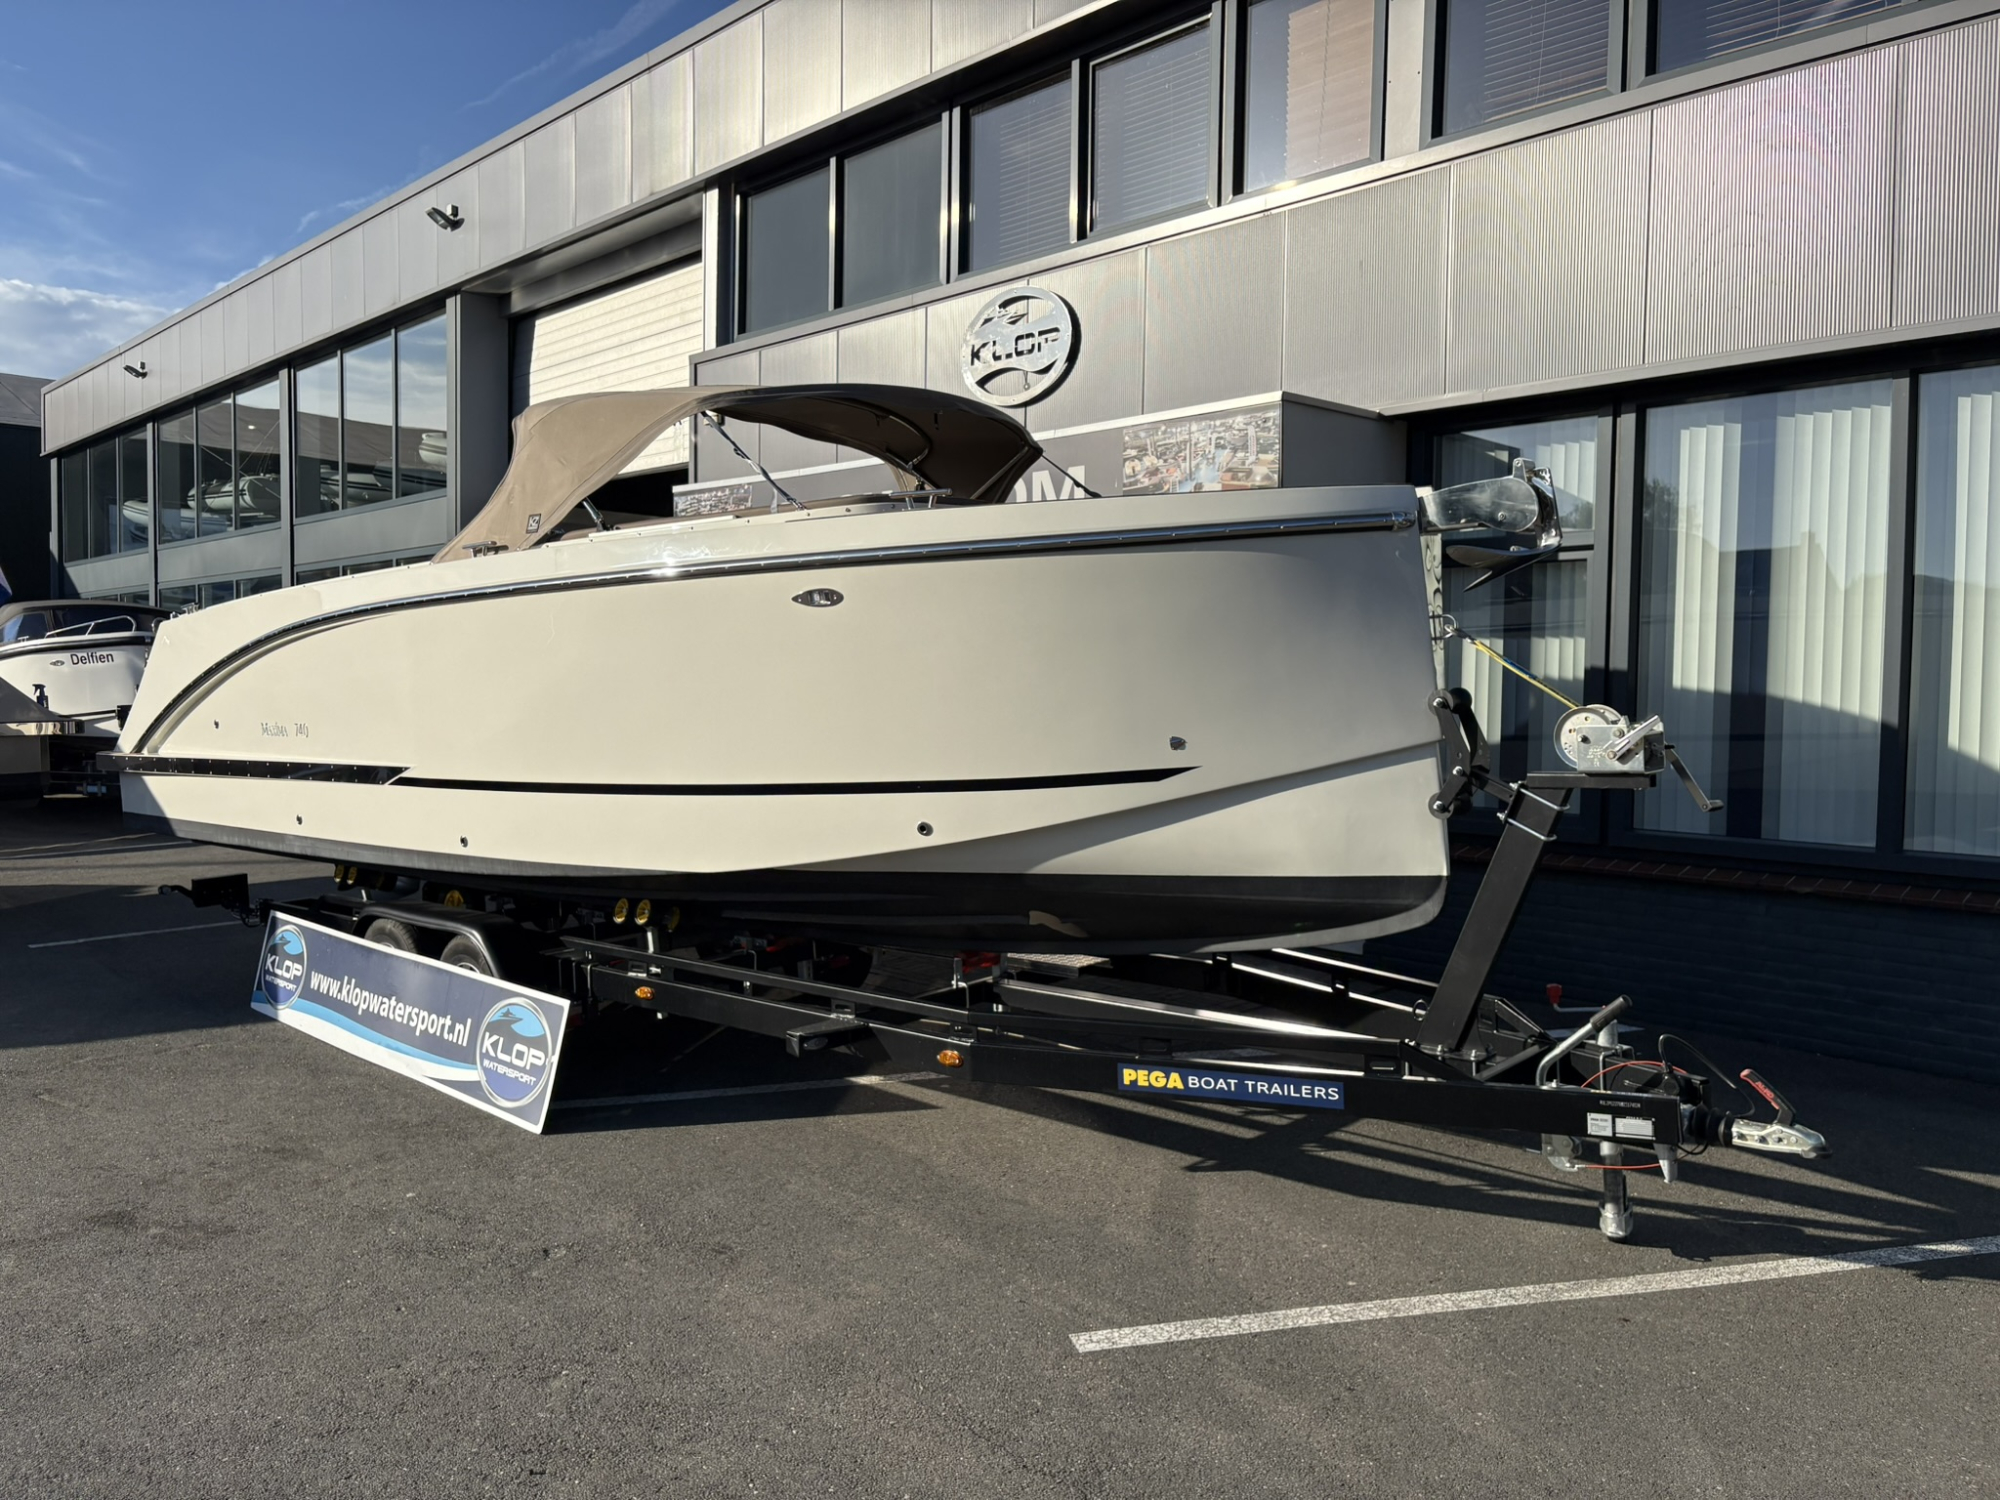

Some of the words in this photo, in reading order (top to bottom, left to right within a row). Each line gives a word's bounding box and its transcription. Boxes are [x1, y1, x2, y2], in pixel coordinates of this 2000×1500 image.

[970, 326, 1061, 366] KLOP
[70, 652, 115, 666] Delfien
[265, 953, 303, 981] KLOP
[265, 974, 298, 992] WATERSPORT
[310, 970, 472, 1047] www.klopwatersport.nl
[482, 1031, 546, 1070] KLOP
[482, 1058, 537, 1086] WATERSPORT
[1122, 1068, 1185, 1090] PEGA
[1187, 1076, 1239, 1092] BOAT
[1244, 1080, 1339, 1100] TRAILERS
